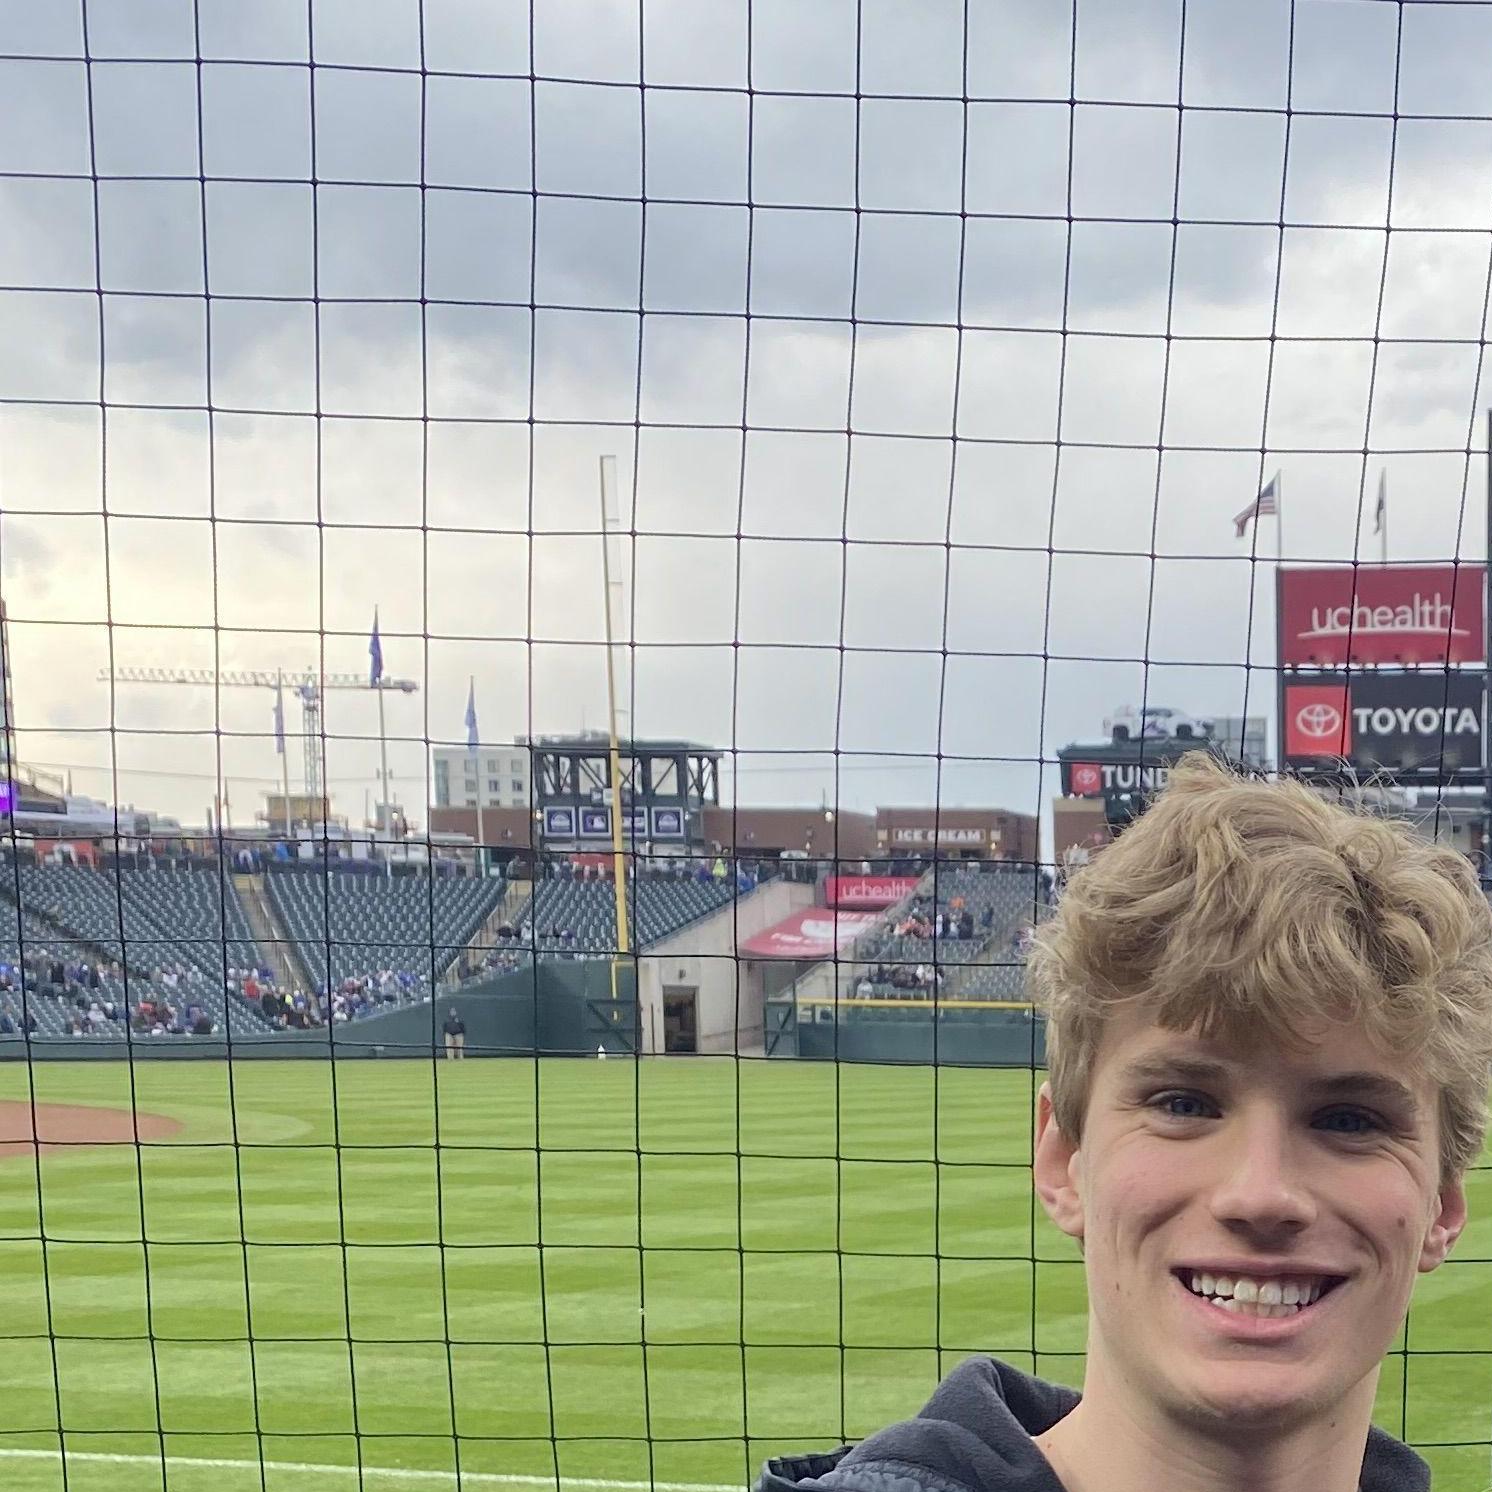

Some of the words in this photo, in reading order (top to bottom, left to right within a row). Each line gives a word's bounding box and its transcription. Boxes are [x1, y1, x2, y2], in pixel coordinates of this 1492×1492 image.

[1311, 592, 1457, 632] uchealth
[1353, 707, 1481, 734] TOYOTA
[898, 830, 923, 842] ICE
[842, 879, 912, 898] uchealth
